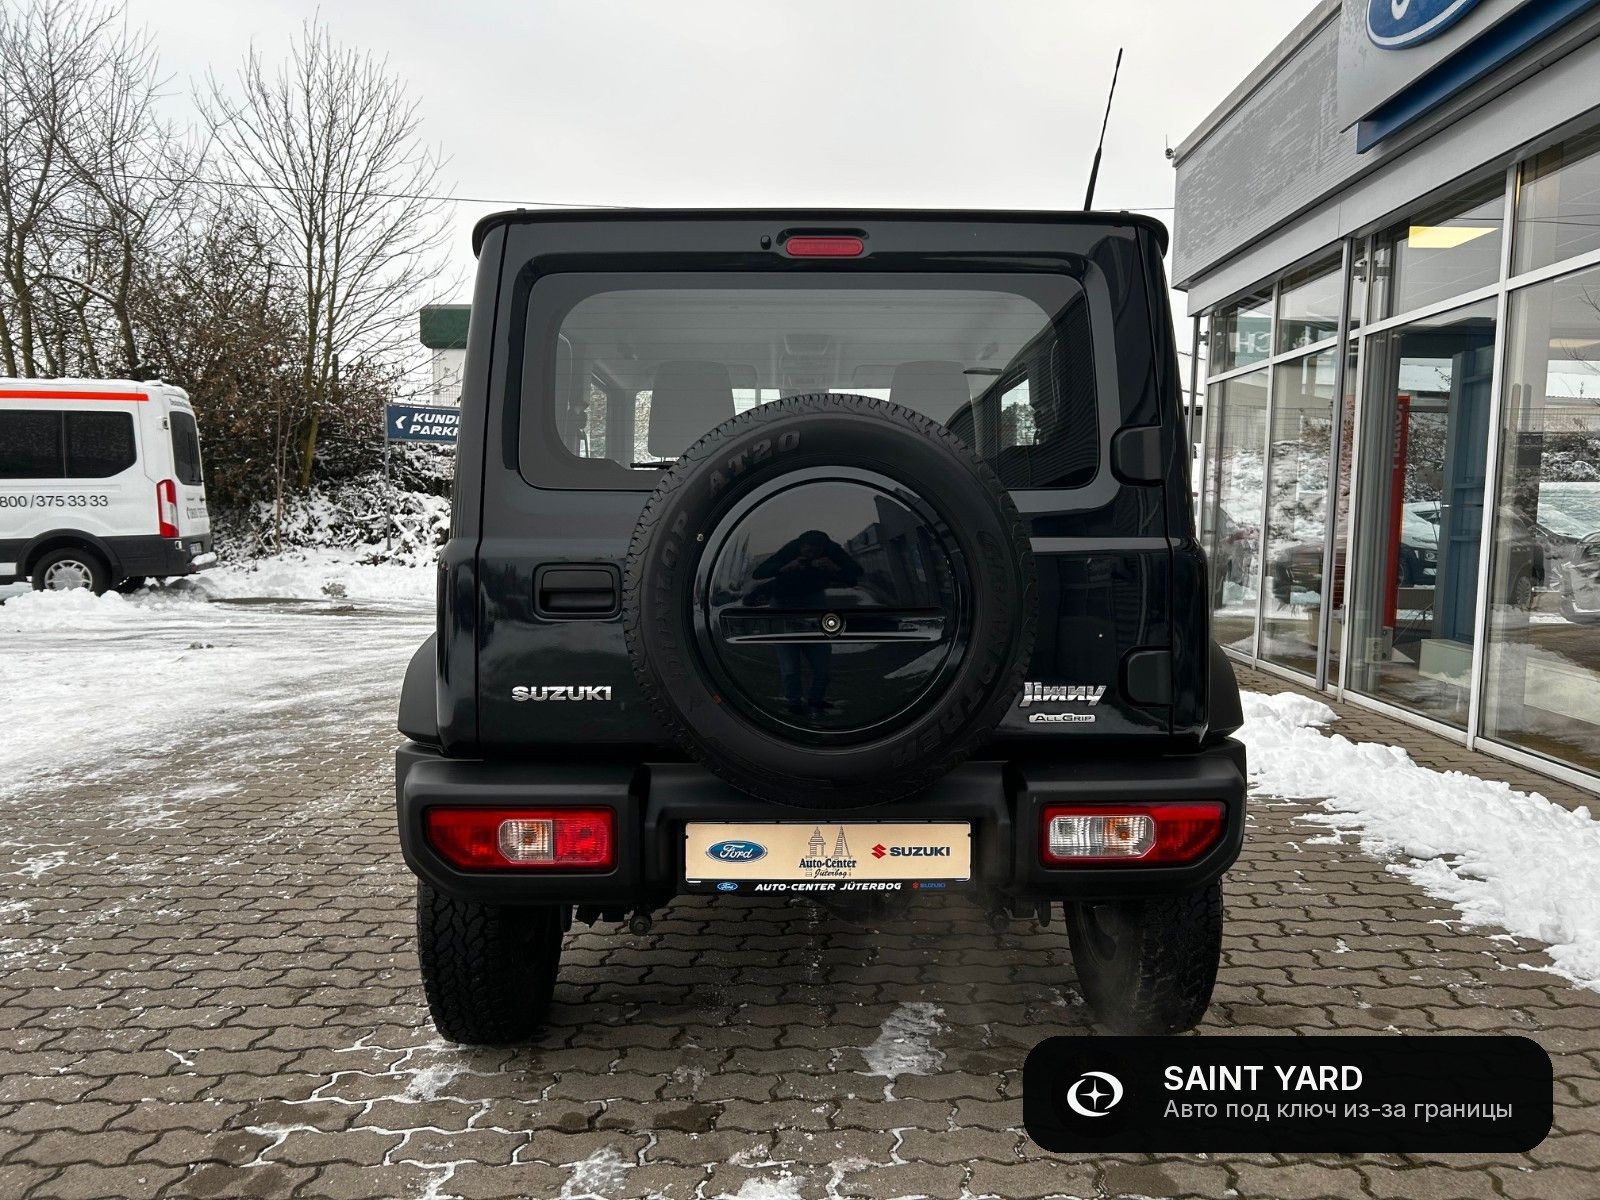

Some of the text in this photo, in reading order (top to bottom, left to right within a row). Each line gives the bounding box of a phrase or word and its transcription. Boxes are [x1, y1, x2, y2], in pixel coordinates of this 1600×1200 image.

[705, 430, 801, 497] AT20
[67, 495, 87, 507] 33
[89, 495, 109, 507] 33
[511, 686, 612, 701] SUZUKI
[890, 846, 951, 857] SUZUKI
[799, 858, 857, 868] Auto-Center
[755, 881, 903, 891] AUTO-CENTER JÜTERBOG
